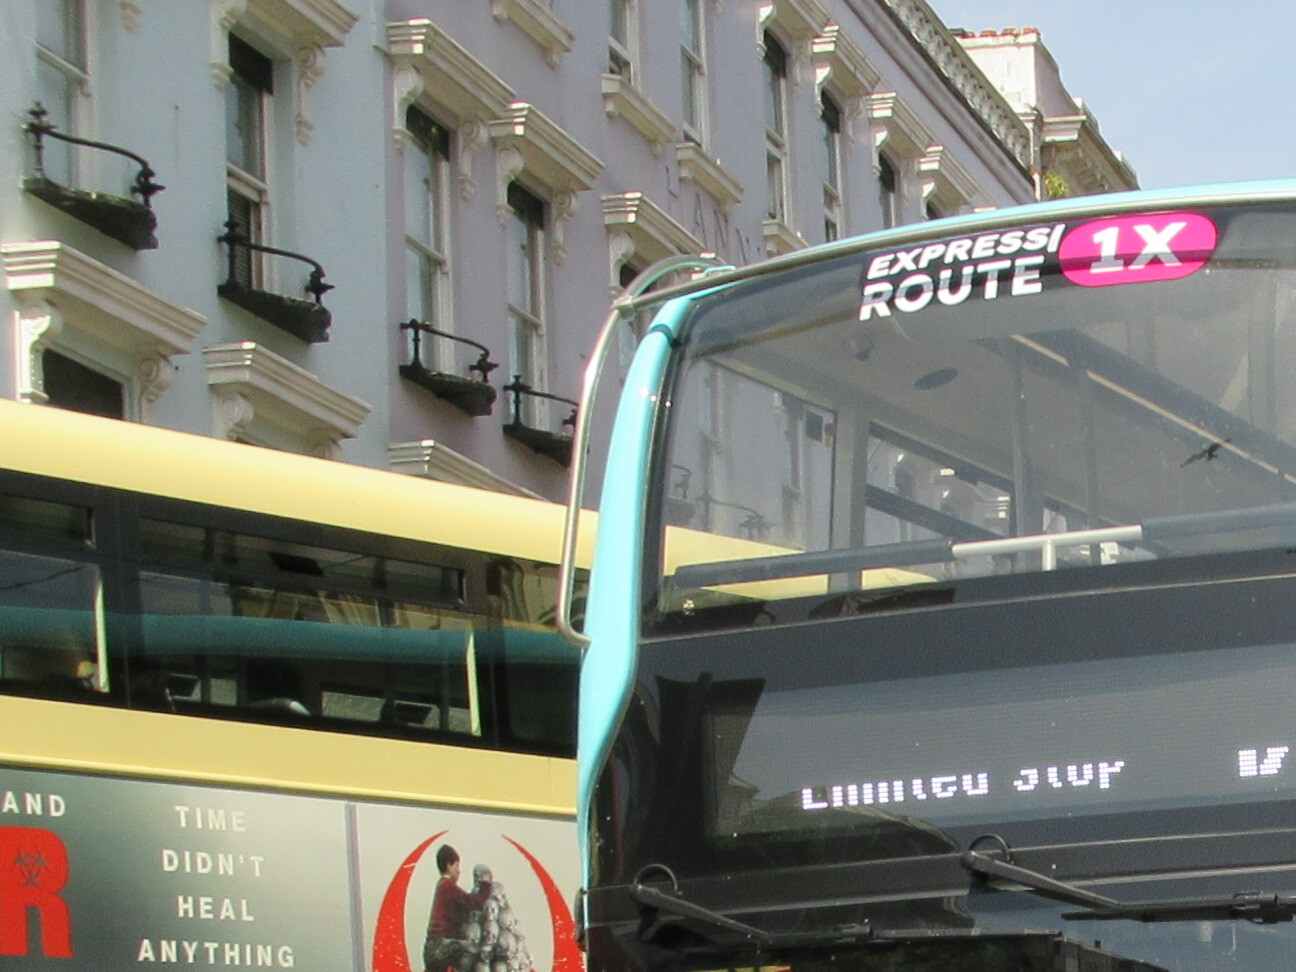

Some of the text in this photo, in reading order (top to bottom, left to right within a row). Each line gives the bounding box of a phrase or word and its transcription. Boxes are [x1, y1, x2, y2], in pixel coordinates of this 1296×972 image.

[1090, 221, 1189, 274] 1X
[858, 255, 1046, 321] ROUTE
[1, 791, 67, 817] AND
[174, 804, 247, 832] TIME
[162, 848, 265, 878] DIDN'T
[177, 894, 256, 921] HEAL
[137, 938, 296, 968] ANYTHING
